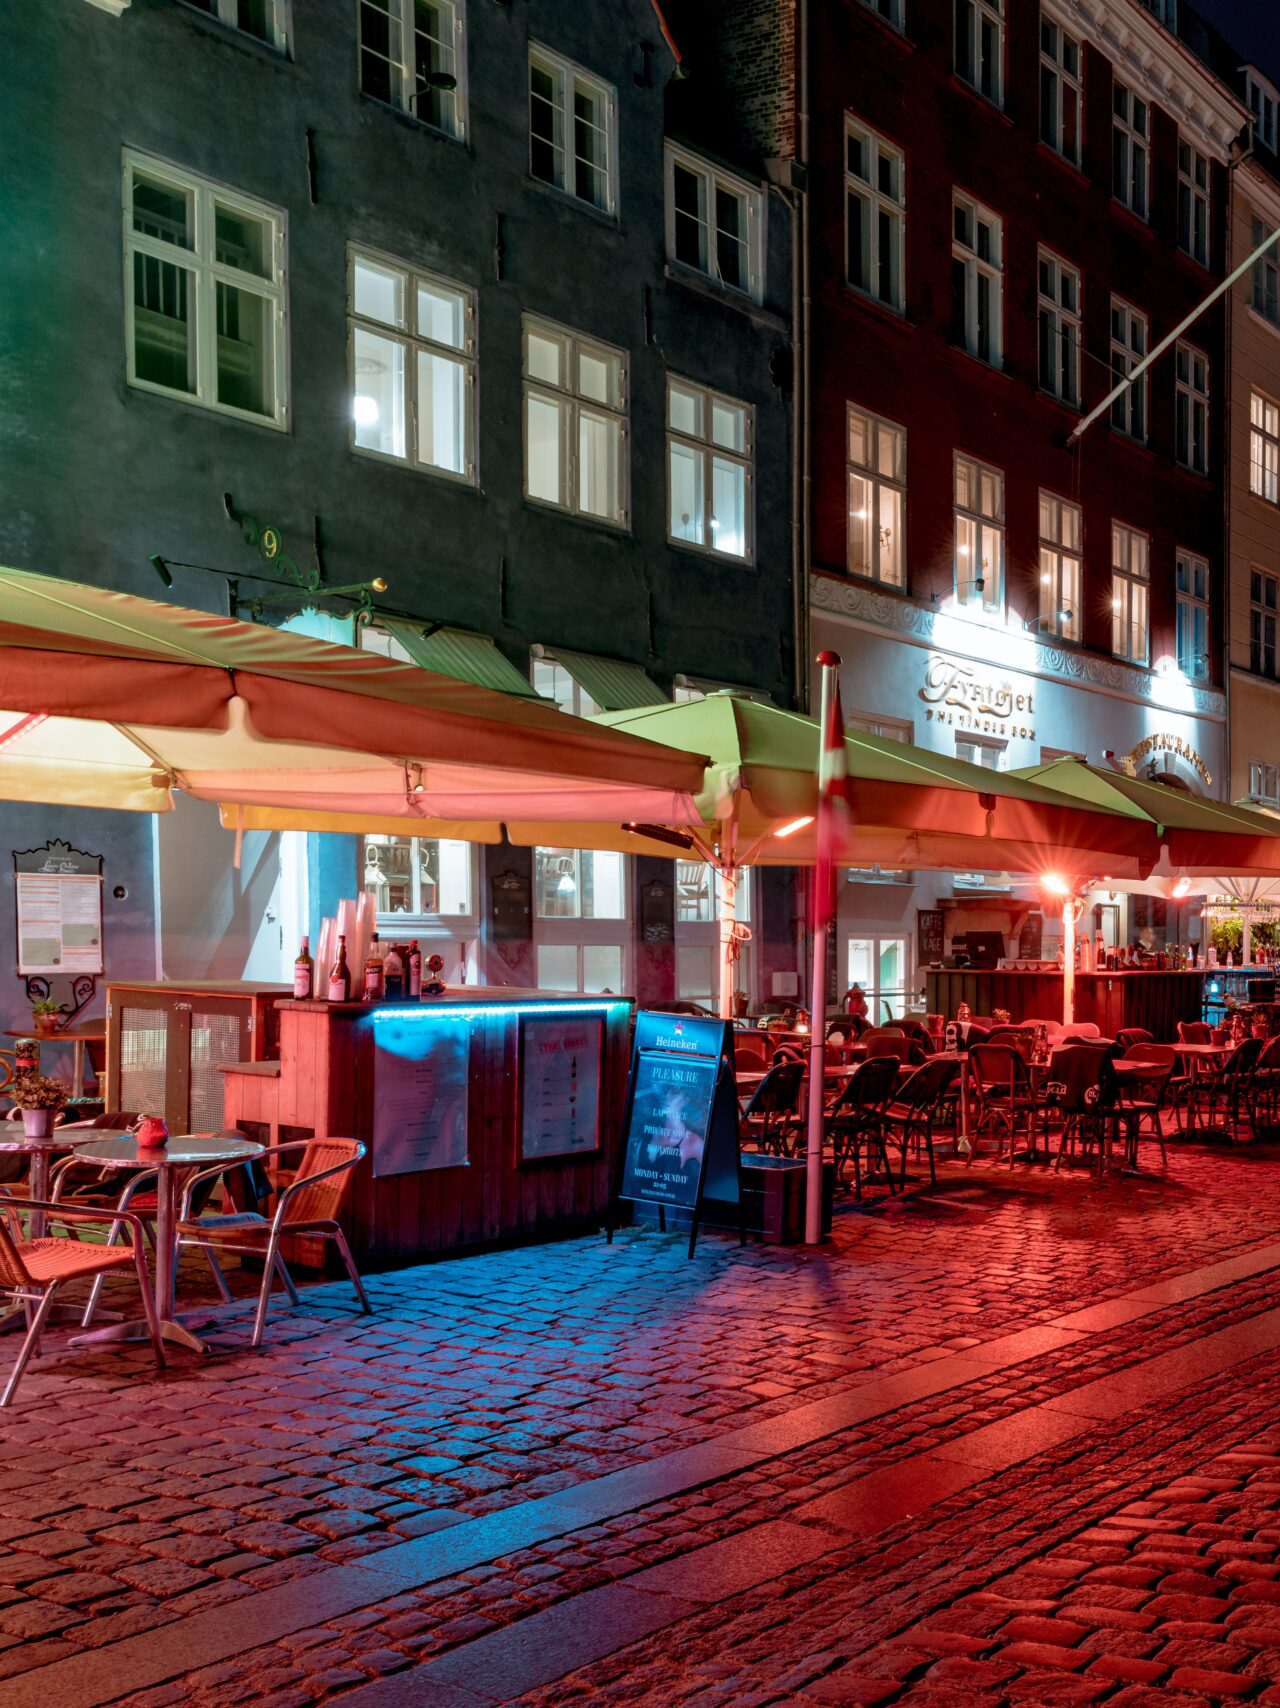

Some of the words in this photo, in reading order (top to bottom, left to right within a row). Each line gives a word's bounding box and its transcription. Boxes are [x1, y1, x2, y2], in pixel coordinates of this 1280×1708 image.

[263, 530, 277, 558] 9
[655, 1036, 699, 1051] Heineken
[651, 1066, 700, 1083] PLEASURE
[643, 1124, 671, 1138] PRIVATE
[633, 1167, 658, 1180] MONDAY
[663, 1172, 689, 1184] SUNDAY
